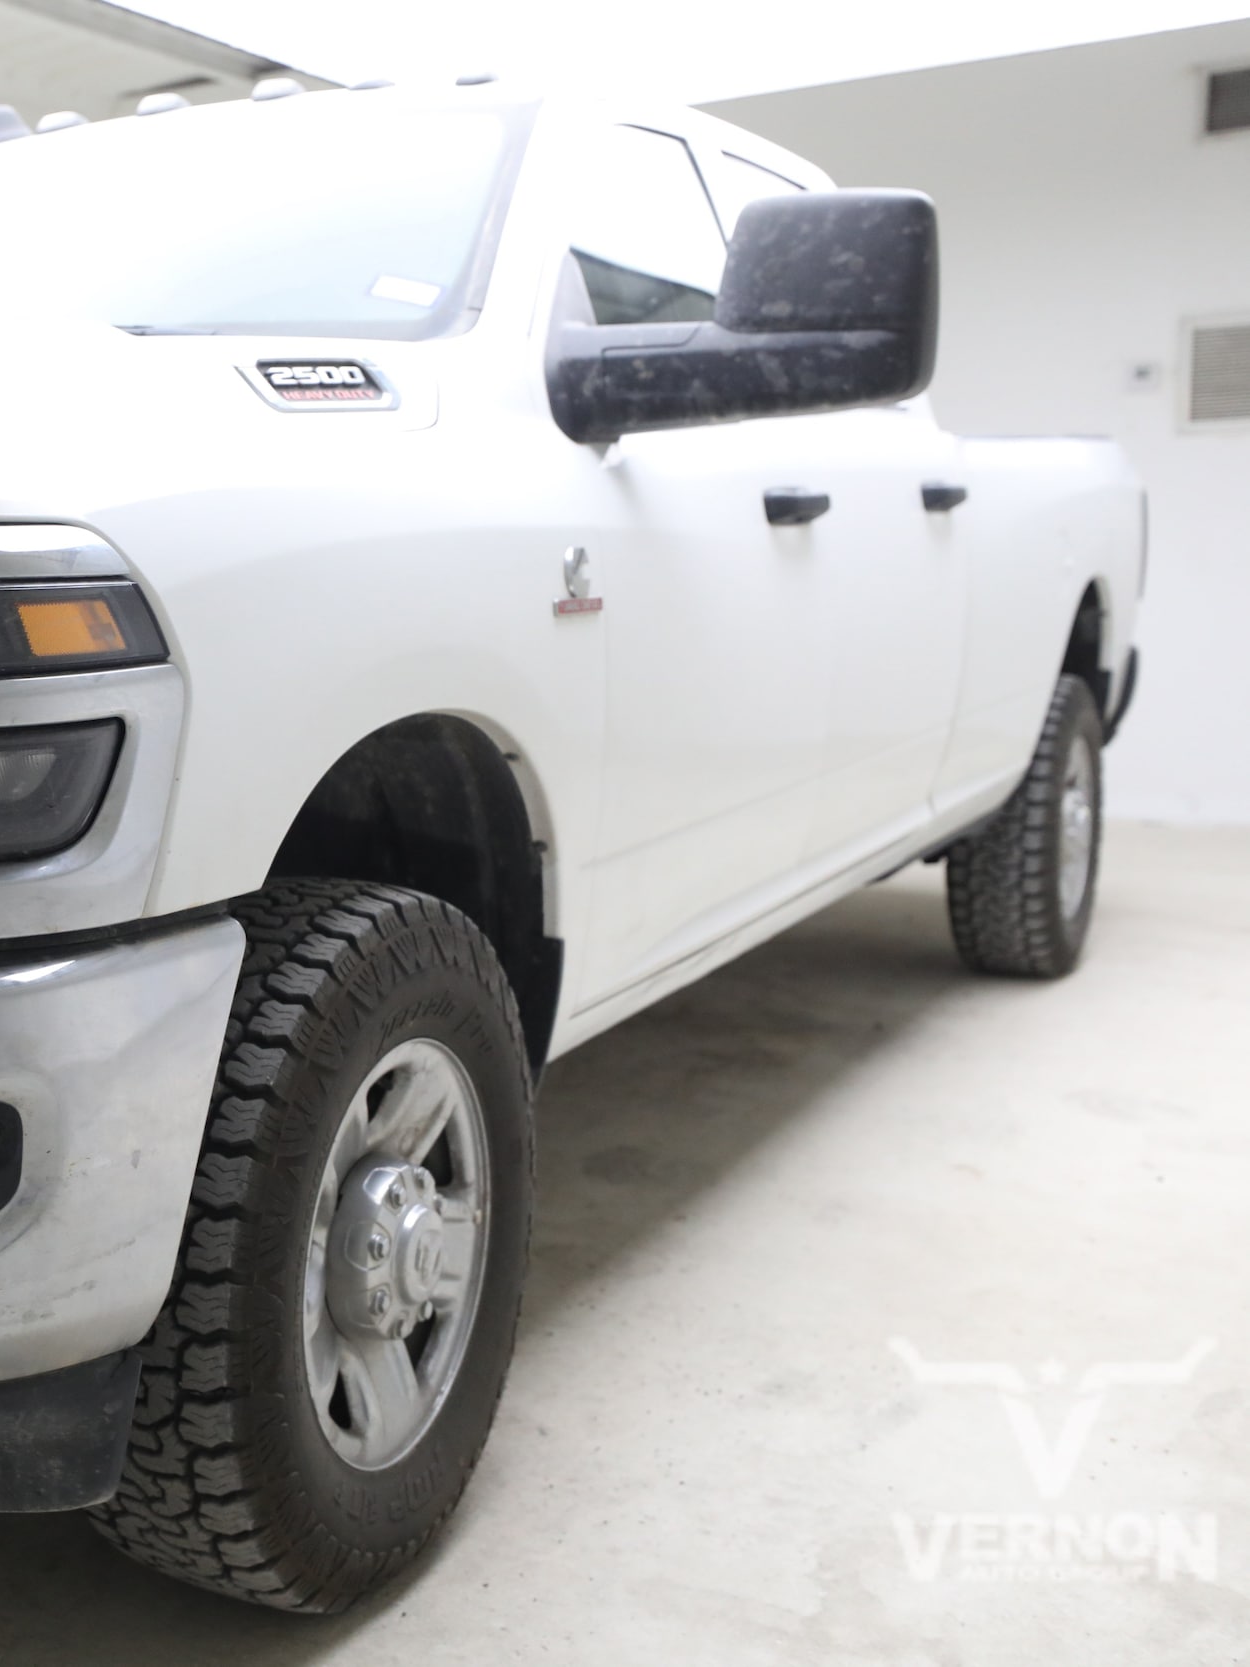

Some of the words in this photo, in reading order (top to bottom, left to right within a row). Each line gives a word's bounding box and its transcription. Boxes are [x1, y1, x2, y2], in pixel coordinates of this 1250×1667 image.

[267, 366, 366, 385] 2500
[281, 390, 335, 400] HEAVY
[336, 390, 376, 400] DUTY
